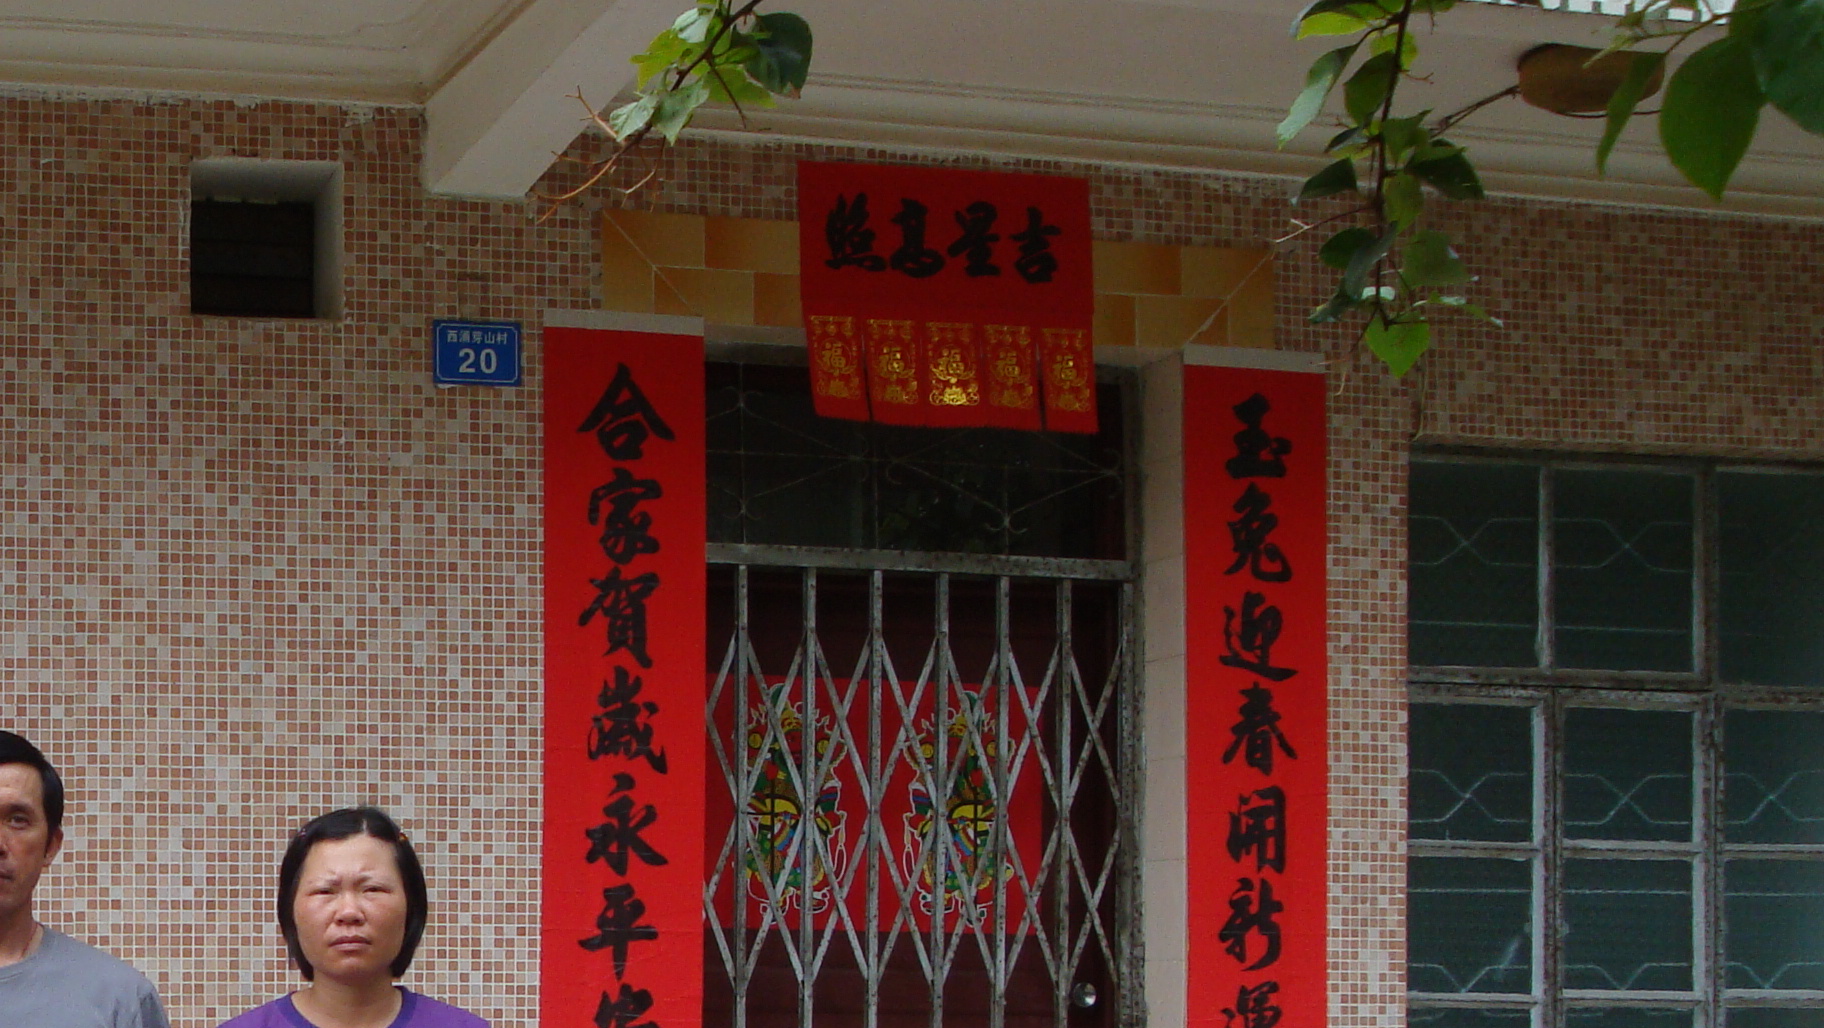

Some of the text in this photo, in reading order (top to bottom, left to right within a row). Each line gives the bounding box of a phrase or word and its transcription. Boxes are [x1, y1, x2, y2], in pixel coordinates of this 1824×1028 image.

[458, 348, 497, 374] 20
[822, 342, 1078, 381] 福 福 福 福 福
